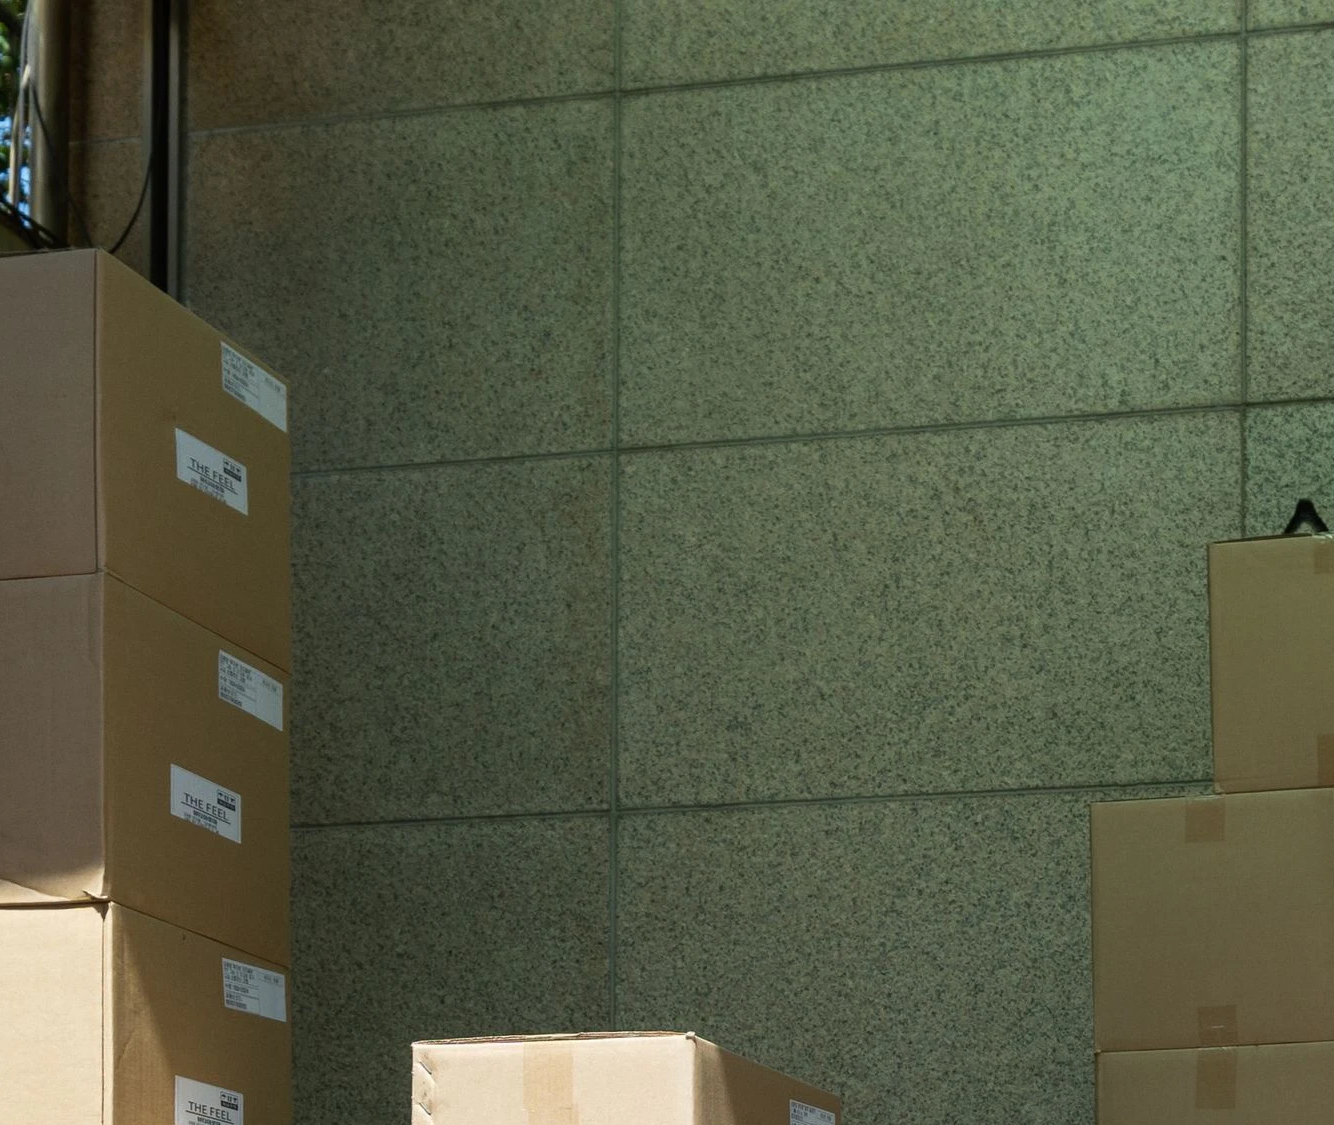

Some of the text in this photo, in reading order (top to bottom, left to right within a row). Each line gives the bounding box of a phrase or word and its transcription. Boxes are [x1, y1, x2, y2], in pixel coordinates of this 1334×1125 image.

[190, 457, 211, 477] THE
[212, 469, 236, 491] FEEL
[183, 792, 204, 811] THE
[206, 803, 229, 822] FEEL
[188, 1101, 208, 1116] THE
[209, 1107, 232, 1122] FEEL
